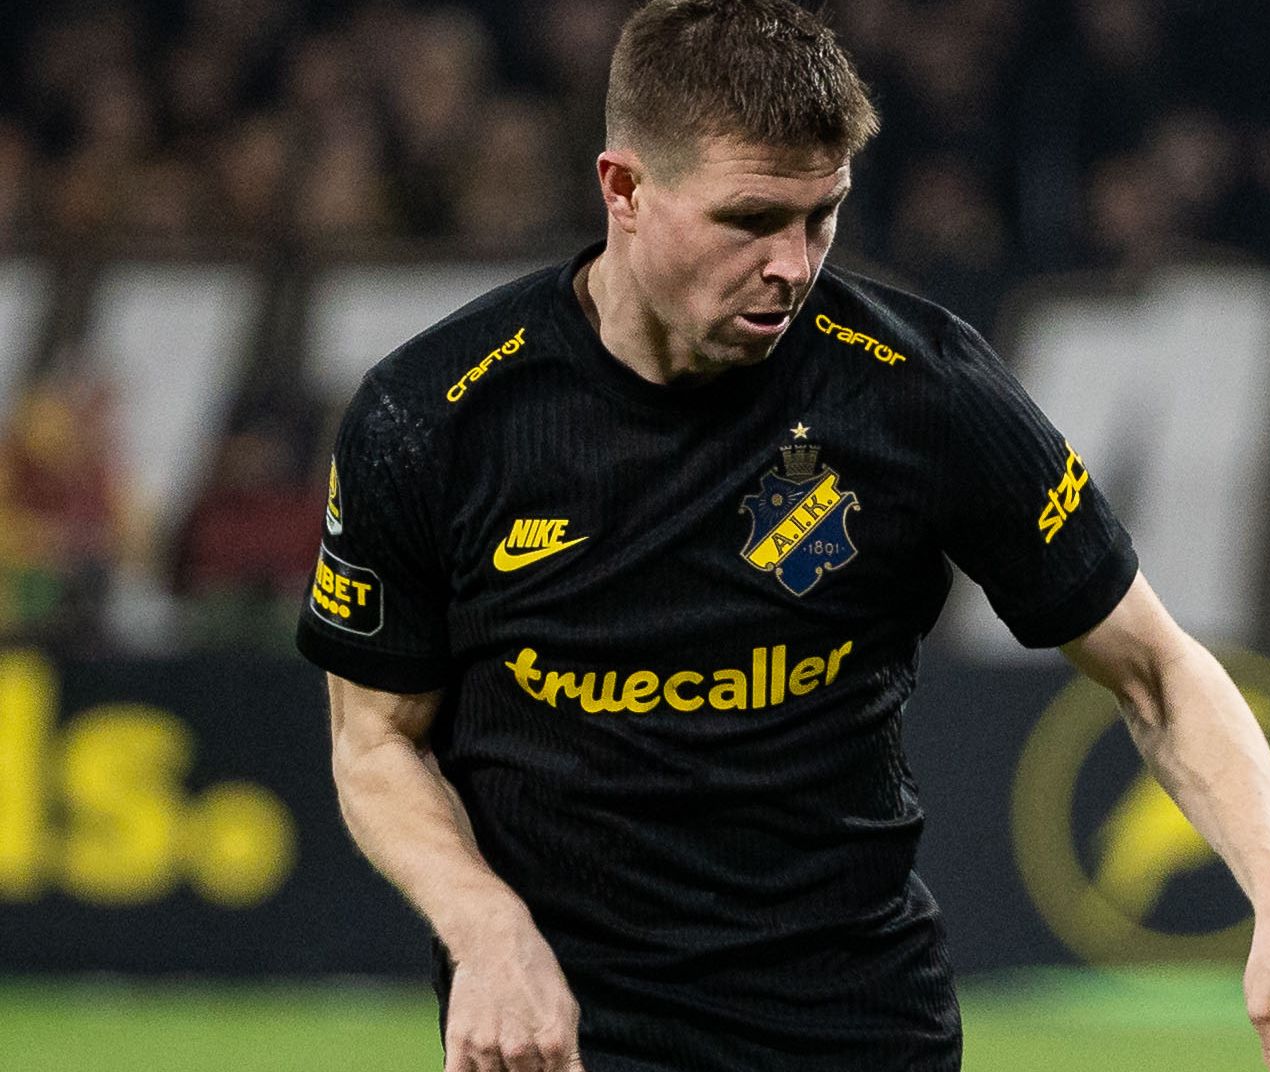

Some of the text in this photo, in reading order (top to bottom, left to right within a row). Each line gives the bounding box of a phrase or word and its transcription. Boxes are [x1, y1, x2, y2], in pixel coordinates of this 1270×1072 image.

[1039, 440, 1089, 544] stac
[506, 519, 569, 548] NIKE
[505, 641, 853, 713] truecaller
